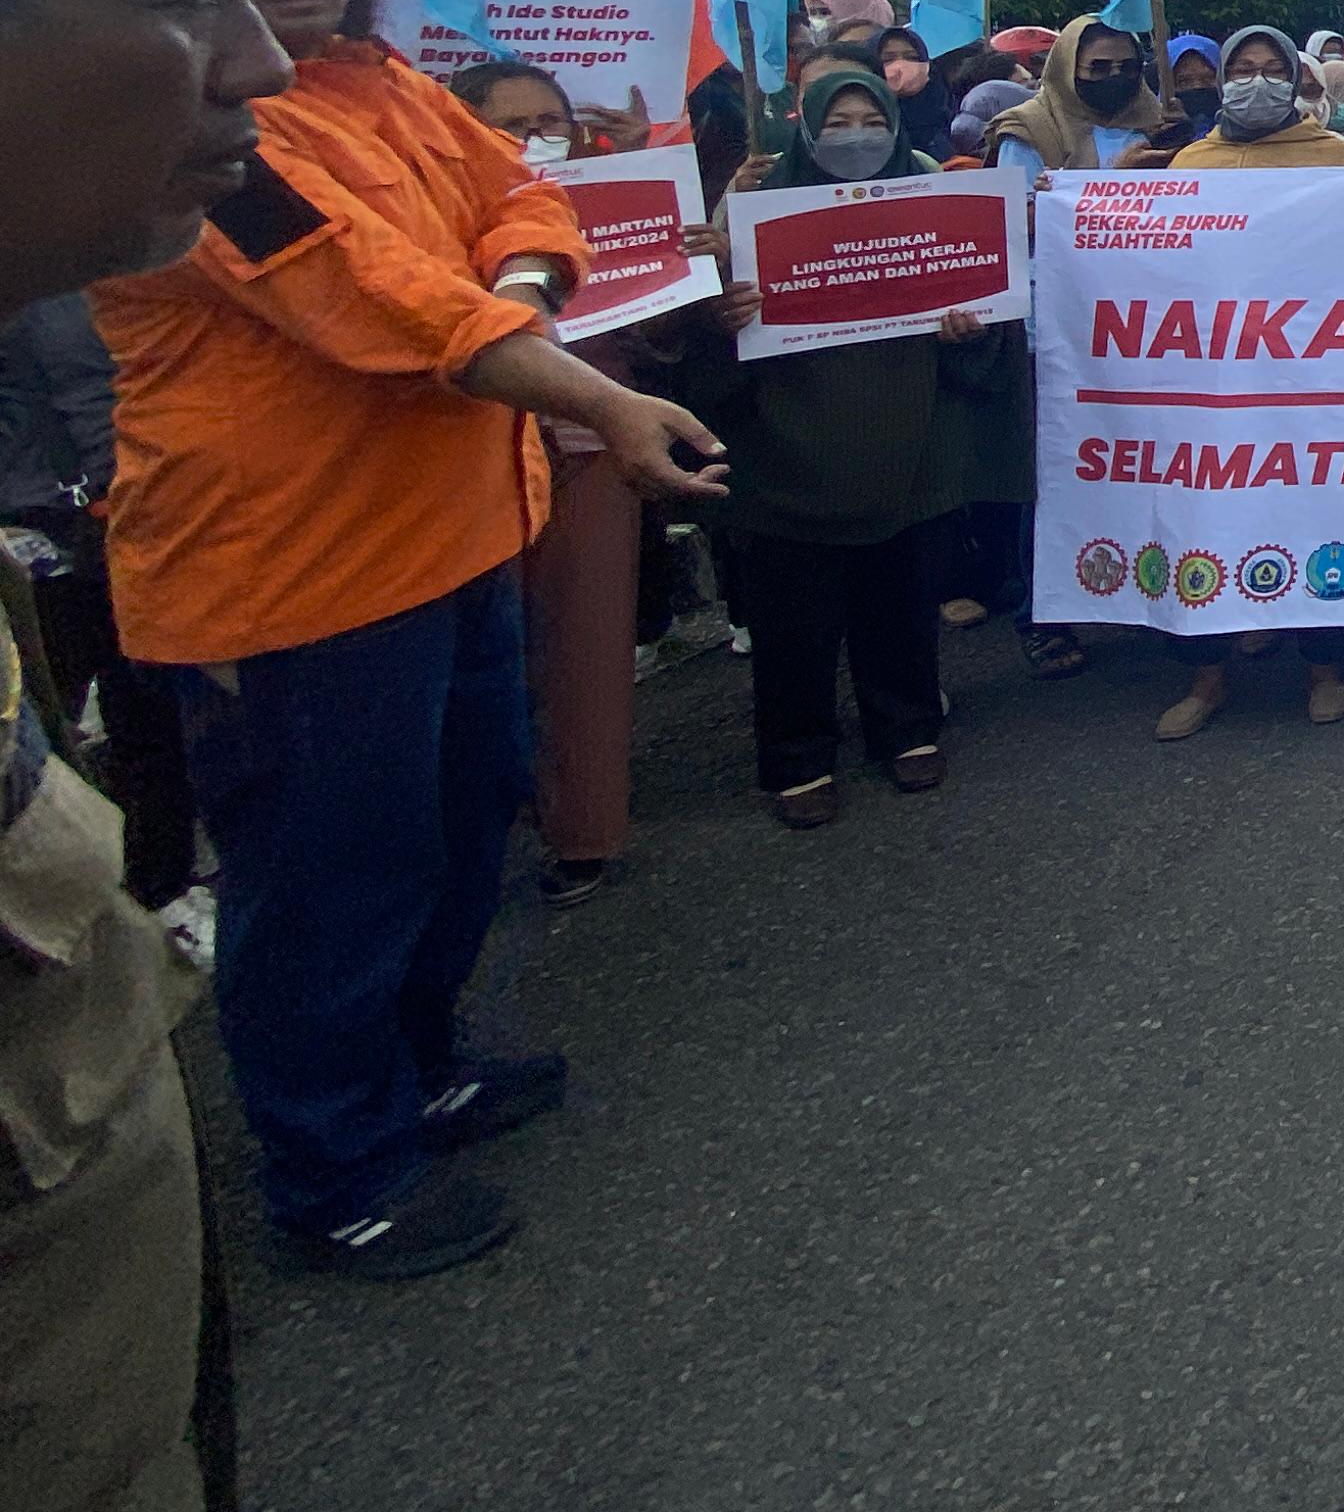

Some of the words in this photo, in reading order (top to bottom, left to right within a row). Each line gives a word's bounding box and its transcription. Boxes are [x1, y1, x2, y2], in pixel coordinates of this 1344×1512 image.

[507, 3, 546, 19] Ide
[551, 3, 630, 20] Studio
[555, 27, 655, 45] Haknya.
[1080, 180, 1200, 197] INDONESIA
[1074, 199, 1154, 214] DAMAI
[592, 214, 674, 238] MARTANI
[1074, 215, 1166, 231] PEKERJA
[1170, 214, 1249, 231] BURUH
[833, 231, 937, 255] WUJUDKAN
[1074, 233, 1194, 249] SEJAHTERA
[792, 249, 915, 276] LINGKUNGAN
[920, 240, 978, 259] KERJA
[768, 276, 821, 294] YANG
[826, 269, 880, 286] AMAN
[885, 264, 922, 279] DAN
[926, 252, 1000, 273] NYAMAN
